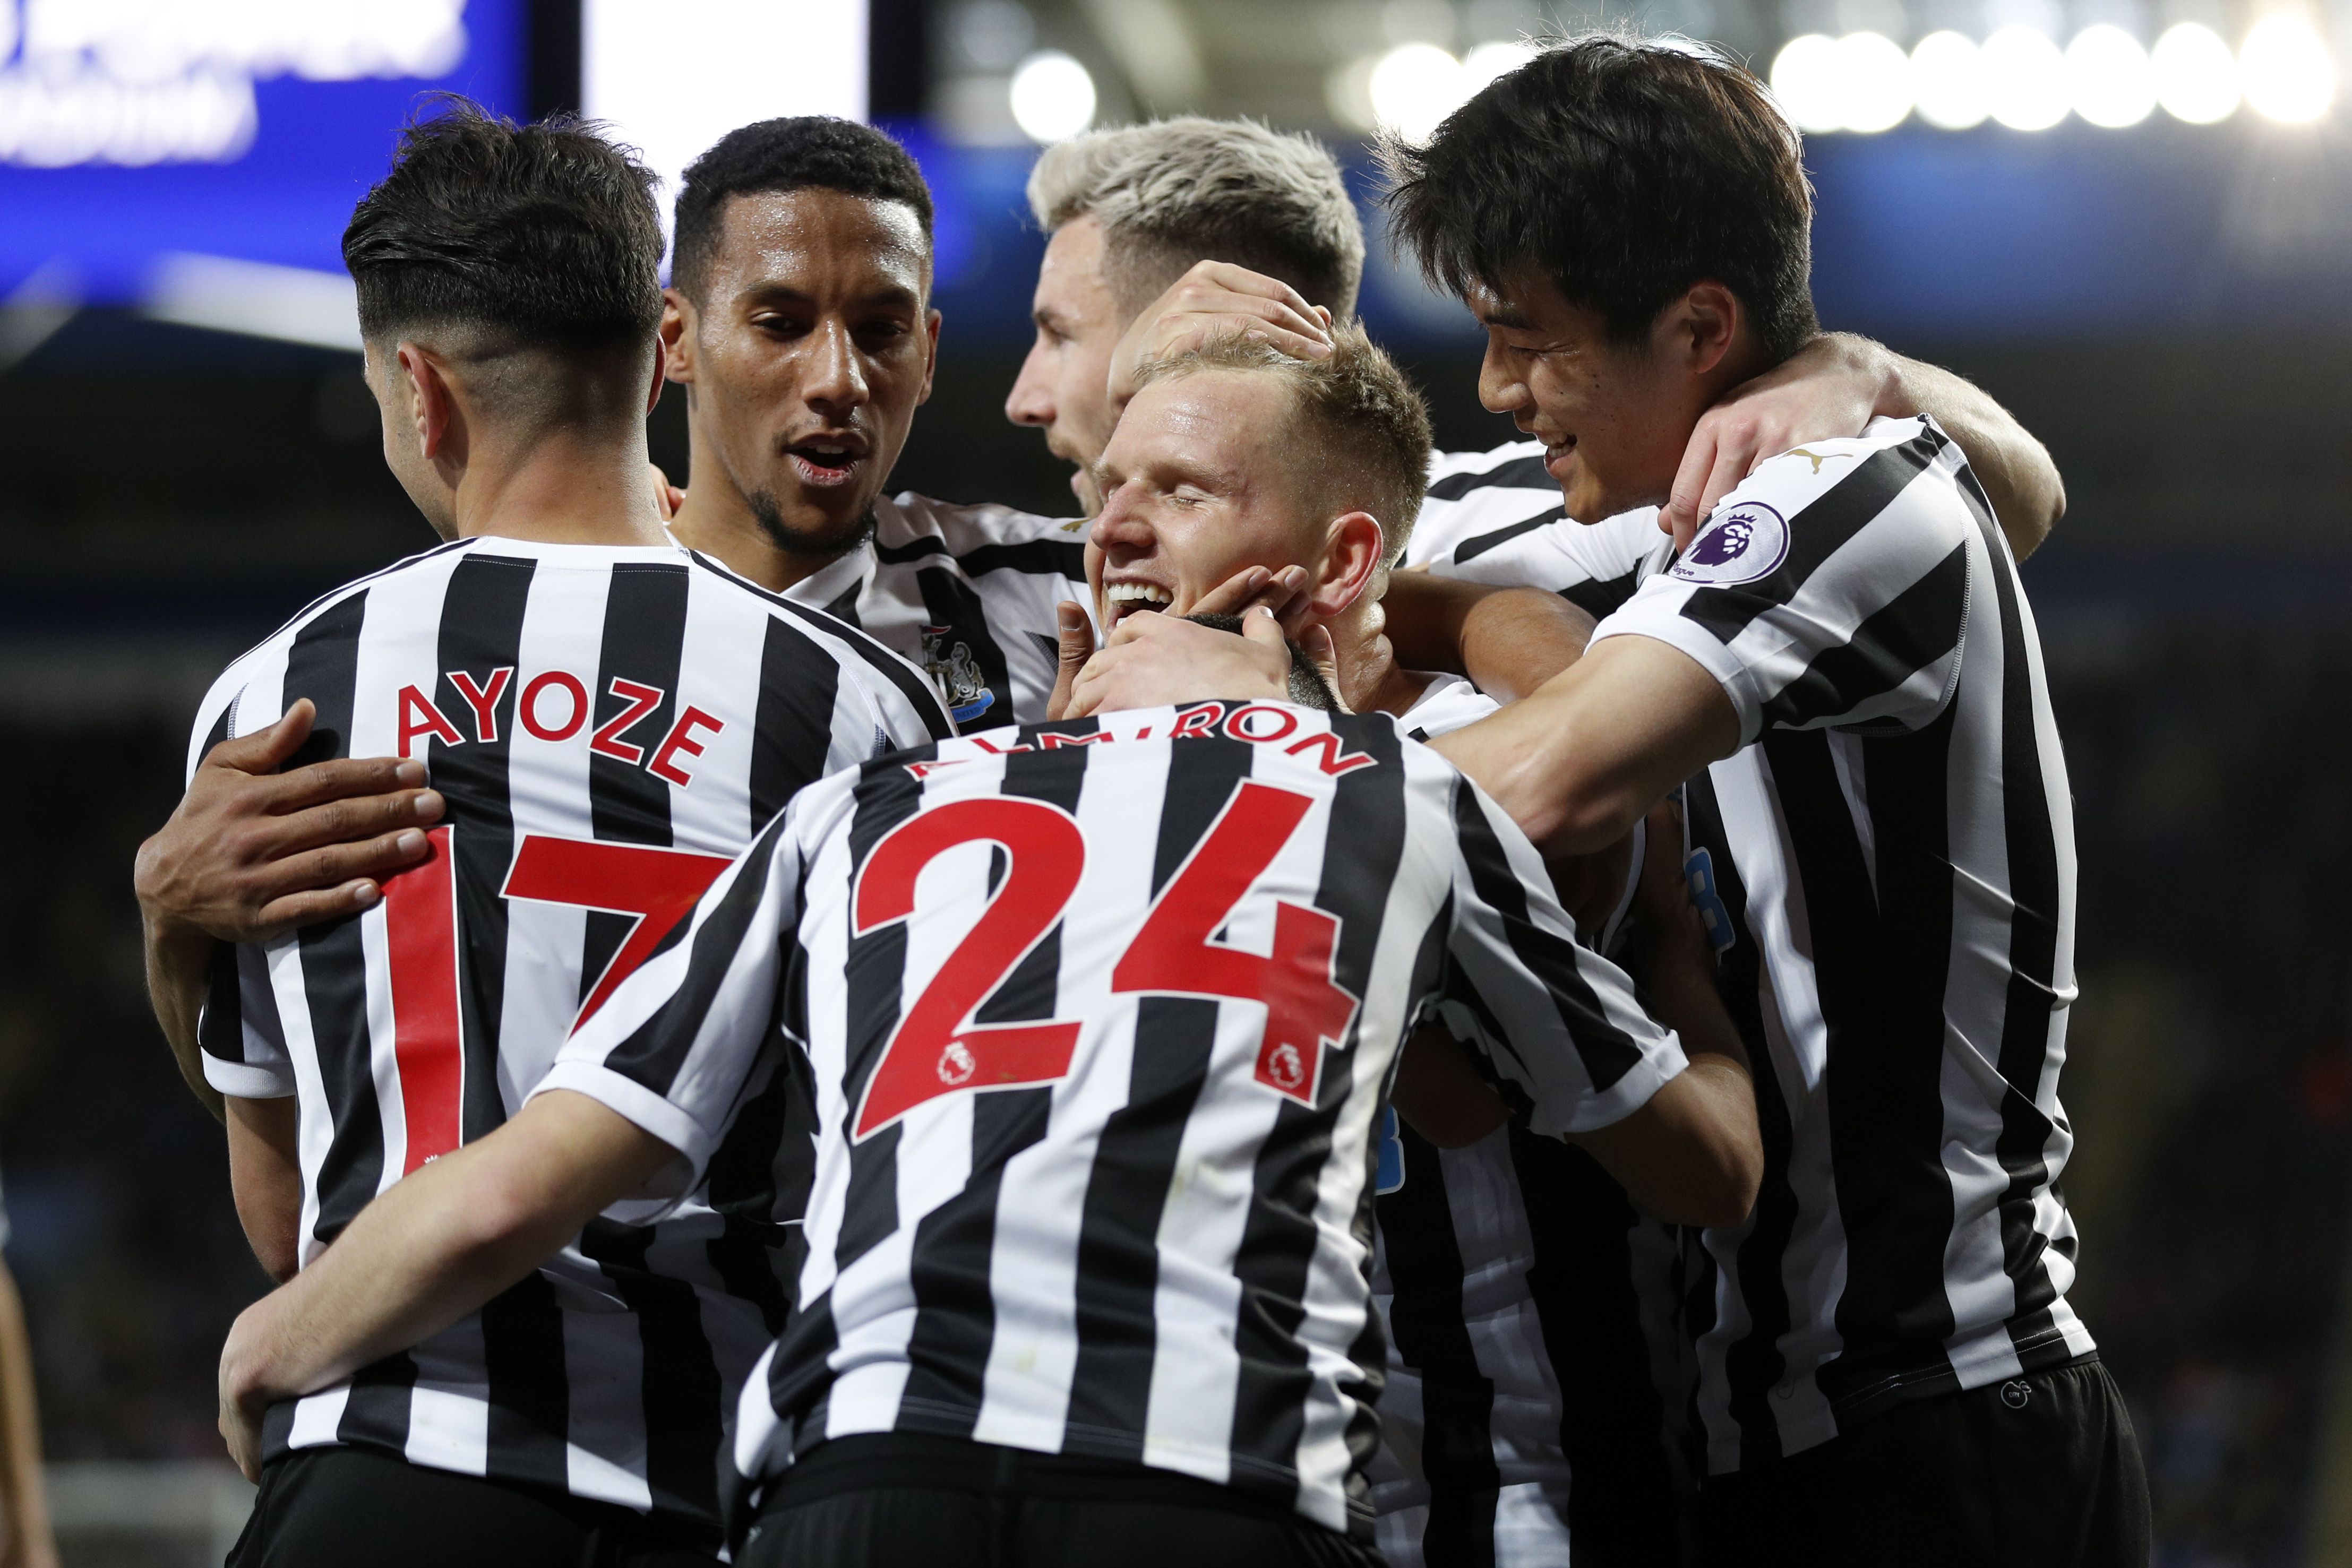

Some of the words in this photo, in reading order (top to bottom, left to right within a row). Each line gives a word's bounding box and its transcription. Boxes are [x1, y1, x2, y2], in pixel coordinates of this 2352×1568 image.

[397, 666, 728, 790] AYOZE
[380, 824, 739, 1175] 17
[852, 776, 1362, 1145] 24
